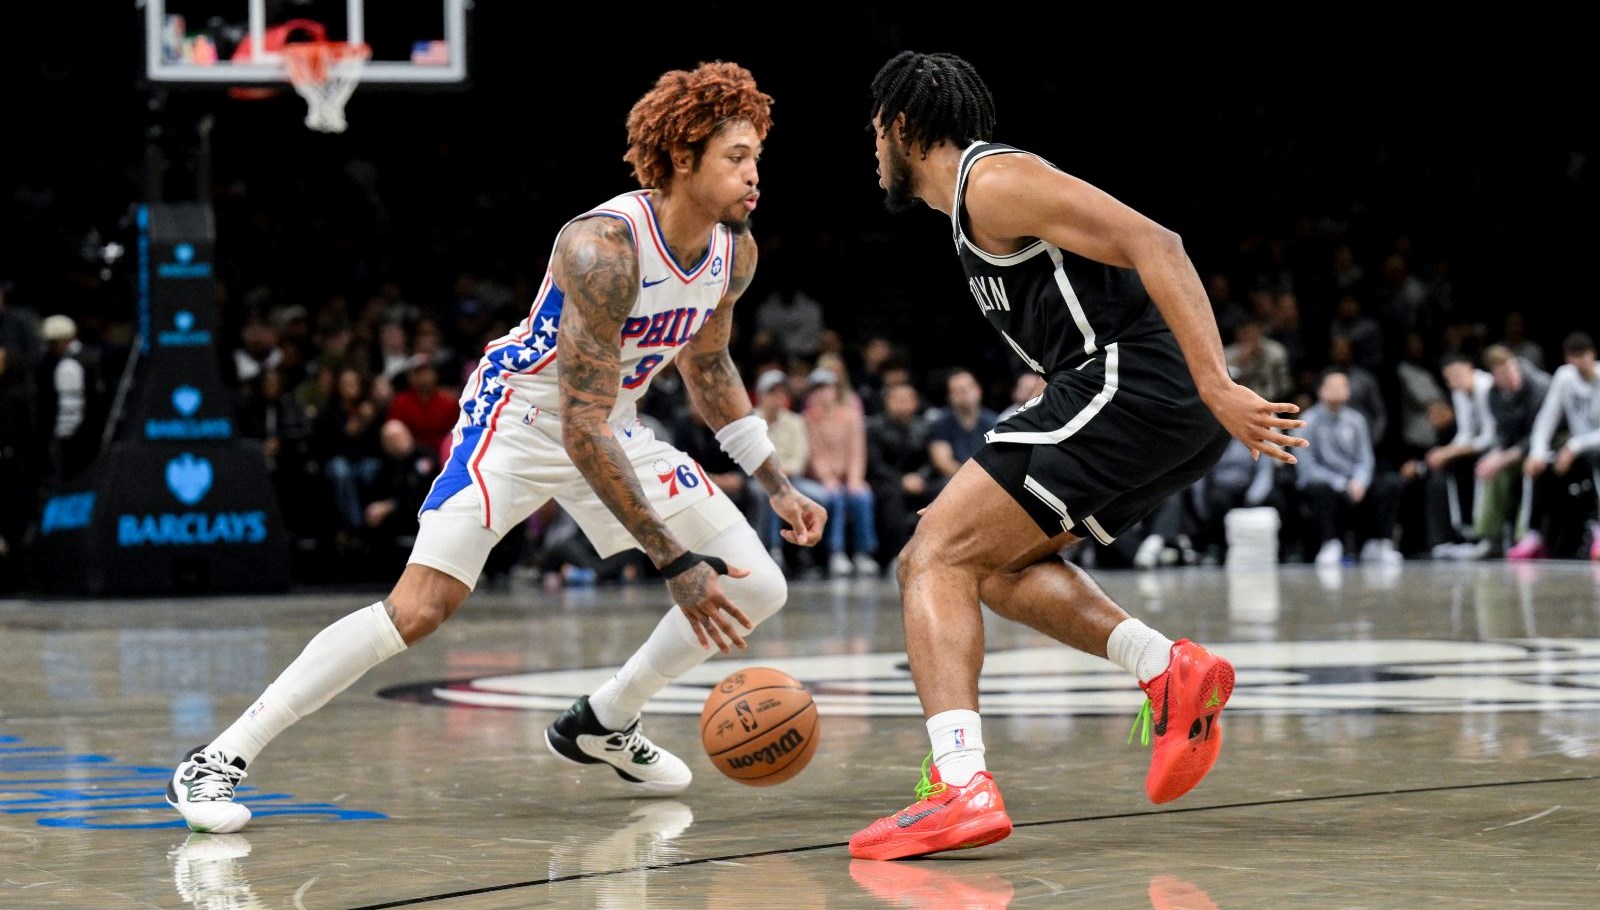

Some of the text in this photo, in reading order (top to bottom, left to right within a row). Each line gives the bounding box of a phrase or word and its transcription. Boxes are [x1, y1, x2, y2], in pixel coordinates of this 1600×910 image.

[622, 354, 664, 390] 9
[657, 464, 699, 498] 76
[117, 511, 267, 546] BARCLAYS
[727, 728, 804, 769] Wilson
